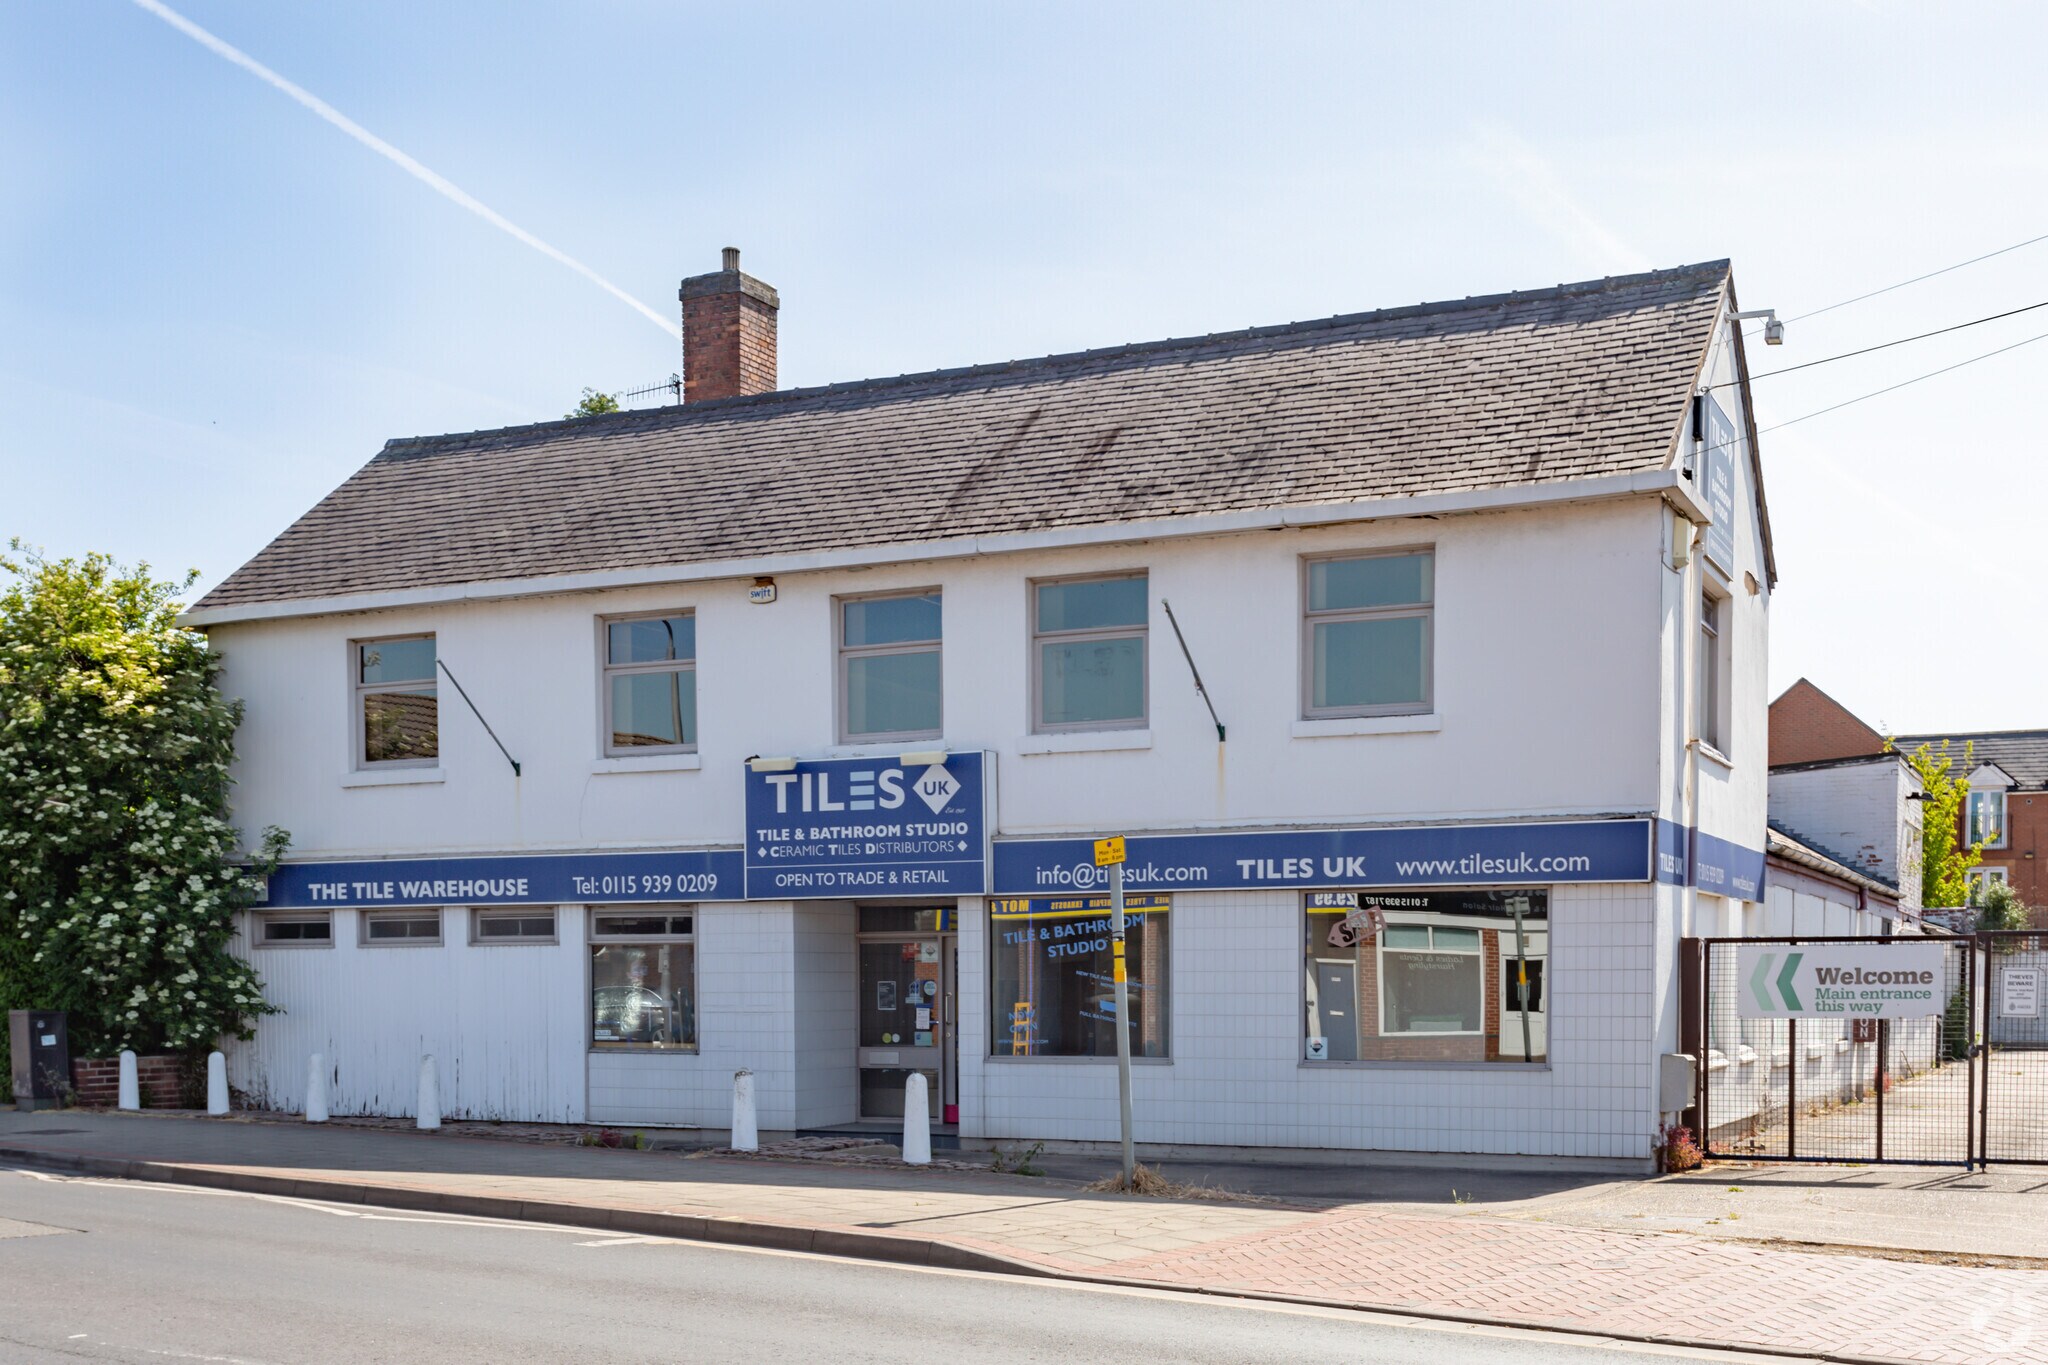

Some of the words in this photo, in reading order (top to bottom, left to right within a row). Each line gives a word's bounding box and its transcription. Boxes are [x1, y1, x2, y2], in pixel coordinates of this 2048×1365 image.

[765, 768, 905, 813] TILES
[923, 781, 949, 796] UK
[757, 829, 790, 841] TILE
[794, 829, 804, 840] &
[810, 825, 900, 839] BATHROOM
[905, 822, 969, 836] STUDIO
[770, 844, 824, 857] CERAMIC
[828, 843, 861, 855] TILES
[865, 840, 955, 854] DISTRIBUTORS
[1236, 858, 1314, 879] TILES
[1323, 857, 1366, 877] UK
[1396, 852, 1590, 876] www.tilesuk.com
[1660, 852, 1674, 873] TILES
[572, 876, 599, 894] Tel:
[602, 876, 637, 894] 0115
[642, 875, 672, 893] 939
[677, 873, 718, 892] 0209
[775, 873, 813, 886] OPEN
[816, 872, 836, 885] TO
[838, 871, 884, 885] TRADE
[888, 871, 898, 884] &
[902, 869, 949, 883] RETAIL
[308, 883, 347, 900] THE
[352, 882, 394, 899] TILE
[399, 879, 528, 898] WAREHOUSE
[1004, 928, 1036, 945] TILE
[1040, 927, 1050, 940] &
[1047, 938, 1108, 958] STUDIO
[1815, 967, 1934, 985] Welcome
[1815, 988, 1856, 1000] Main
[1860, 988, 1932, 1000] entrance
[1815, 1000, 1845, 1012] this
[1848, 1002, 1883, 1015] way
